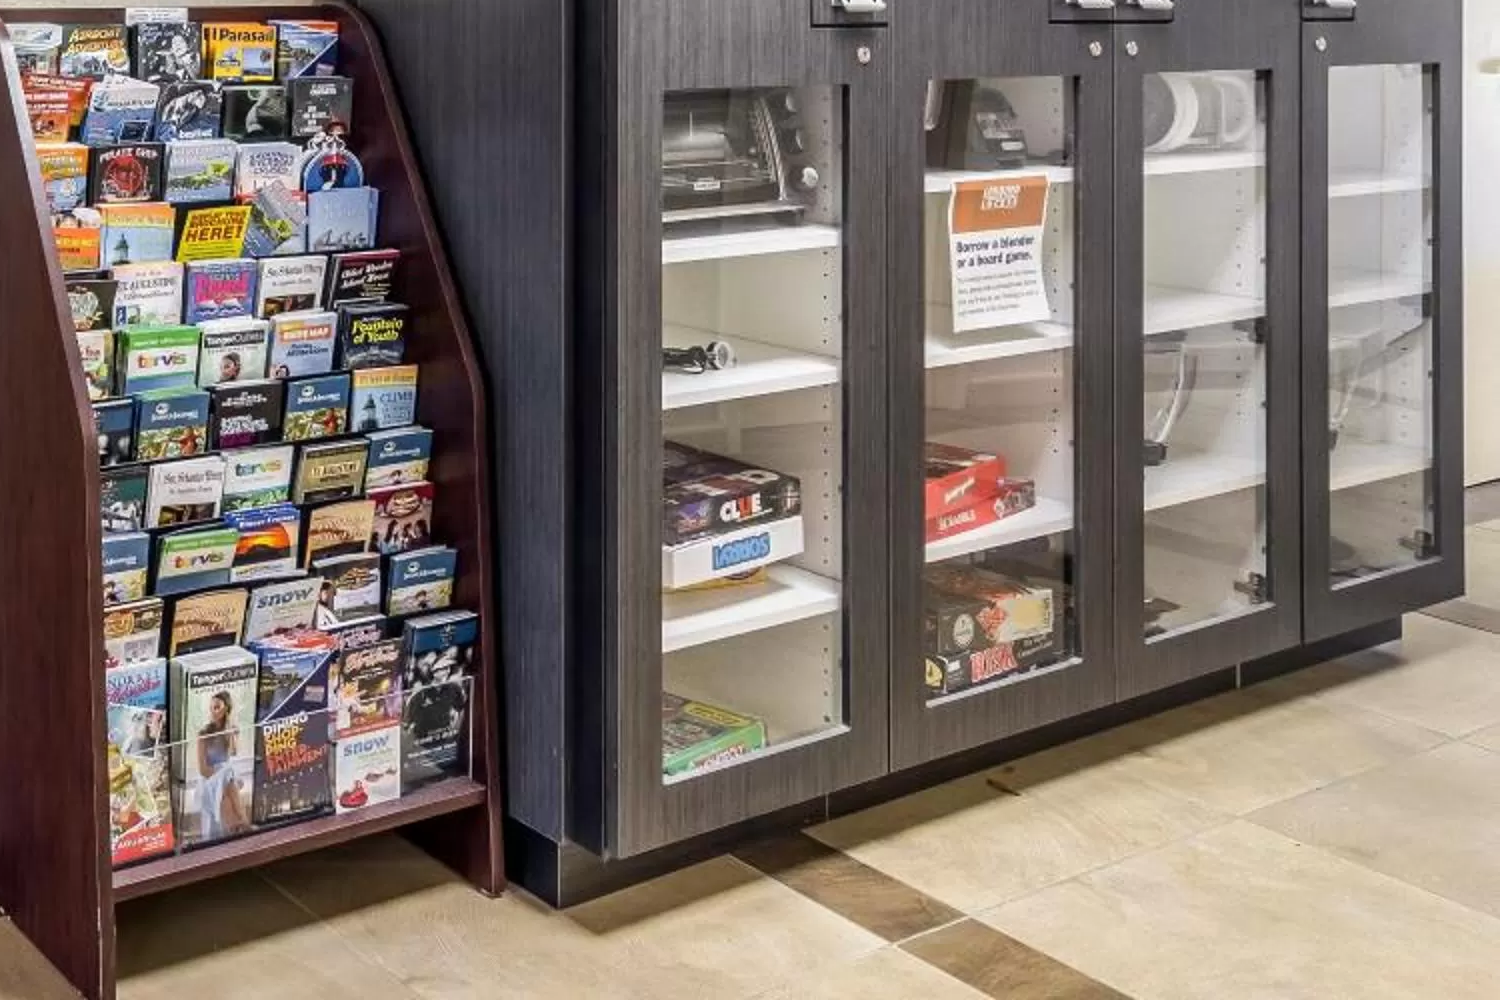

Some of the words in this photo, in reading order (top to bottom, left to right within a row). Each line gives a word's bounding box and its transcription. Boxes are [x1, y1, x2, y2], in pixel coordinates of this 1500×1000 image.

[186, 226, 242, 242] HERE!
[956, 240, 990, 254] Borrow
[1000, 236, 1035, 249] blender
[977, 253, 1002, 268] board
[720, 492, 762, 523] CLUE
